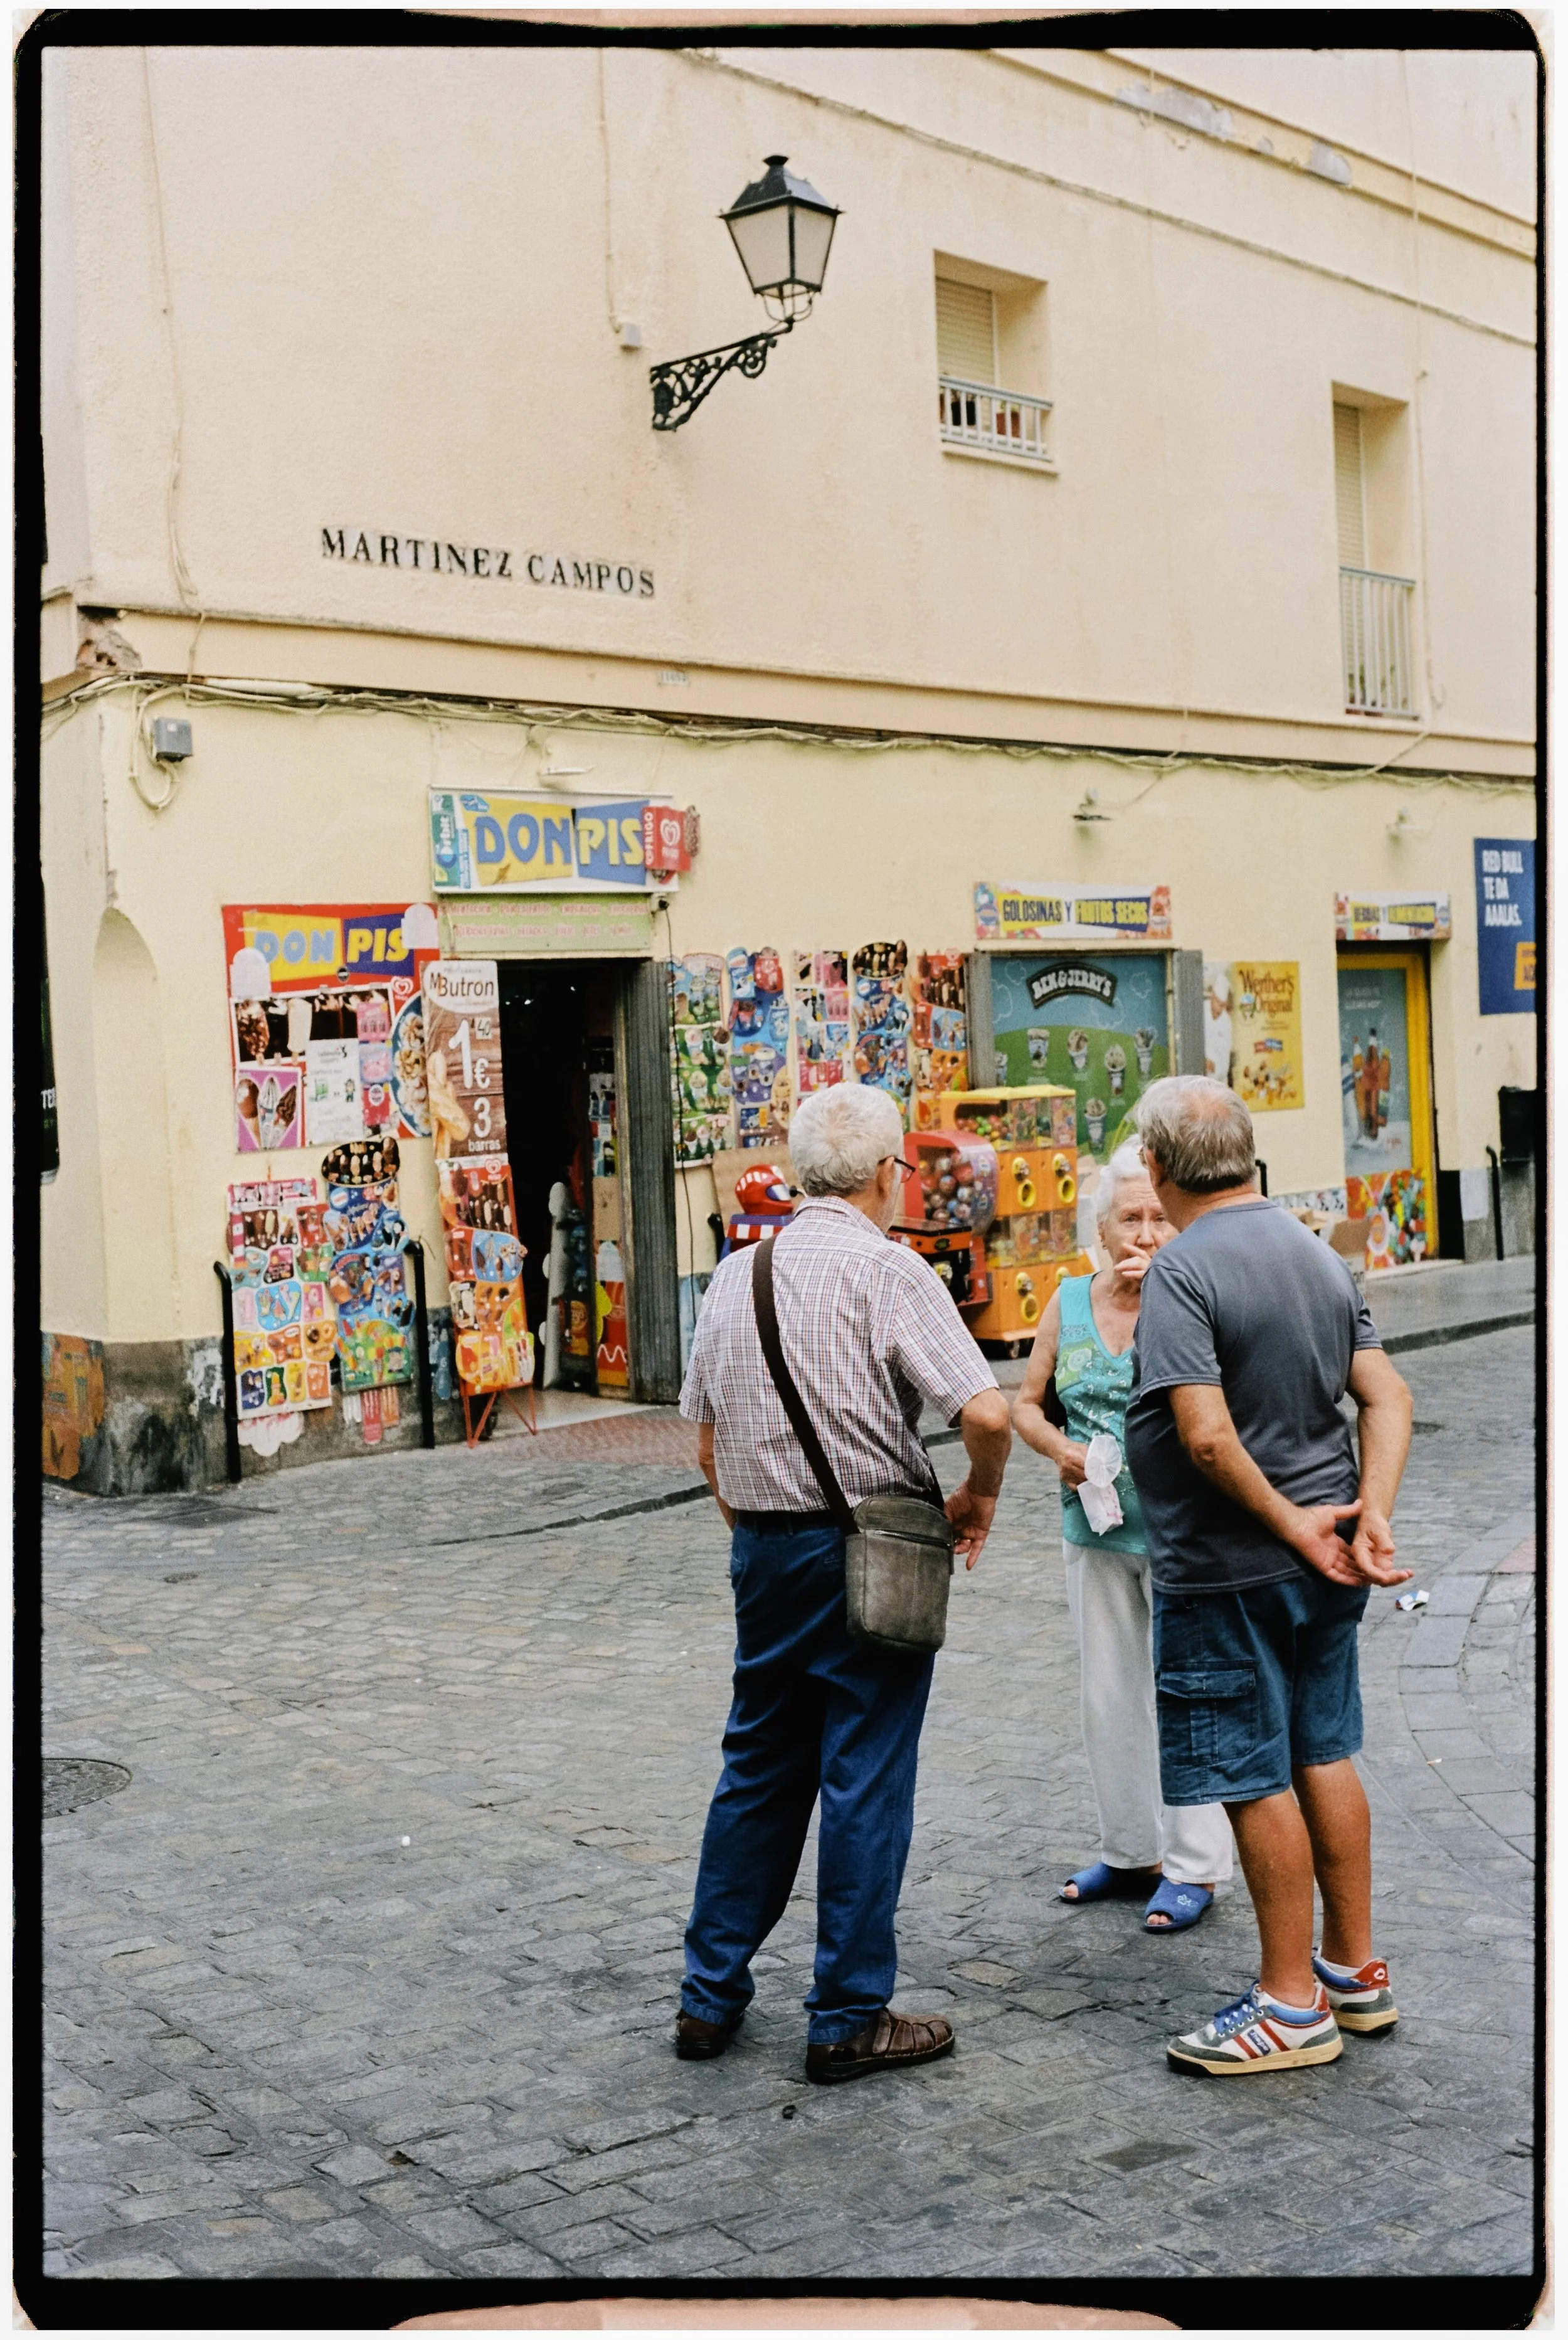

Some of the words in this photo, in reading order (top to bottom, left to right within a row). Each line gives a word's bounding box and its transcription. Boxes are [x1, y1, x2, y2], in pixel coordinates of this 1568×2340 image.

[322, 527, 512, 578] MARTINEZ
[527, 554, 656, 598] CAMPOS
[475, 813, 571, 864] DON
[576, 818, 645, 866] PIS
[1482, 849, 1501, 873] RED
[1502, 850, 1524, 874] BULL
[1483, 876, 1495, 900] TE
[1003, 898, 1062, 922] GOLOSINAS
[1064, 900, 1073, 923] Y
[253, 929, 336, 964] DON
[347, 928, 410, 963] PIS
[473, 1096, 492, 1138] 3
[468, 1138, 501, 1152] barras
